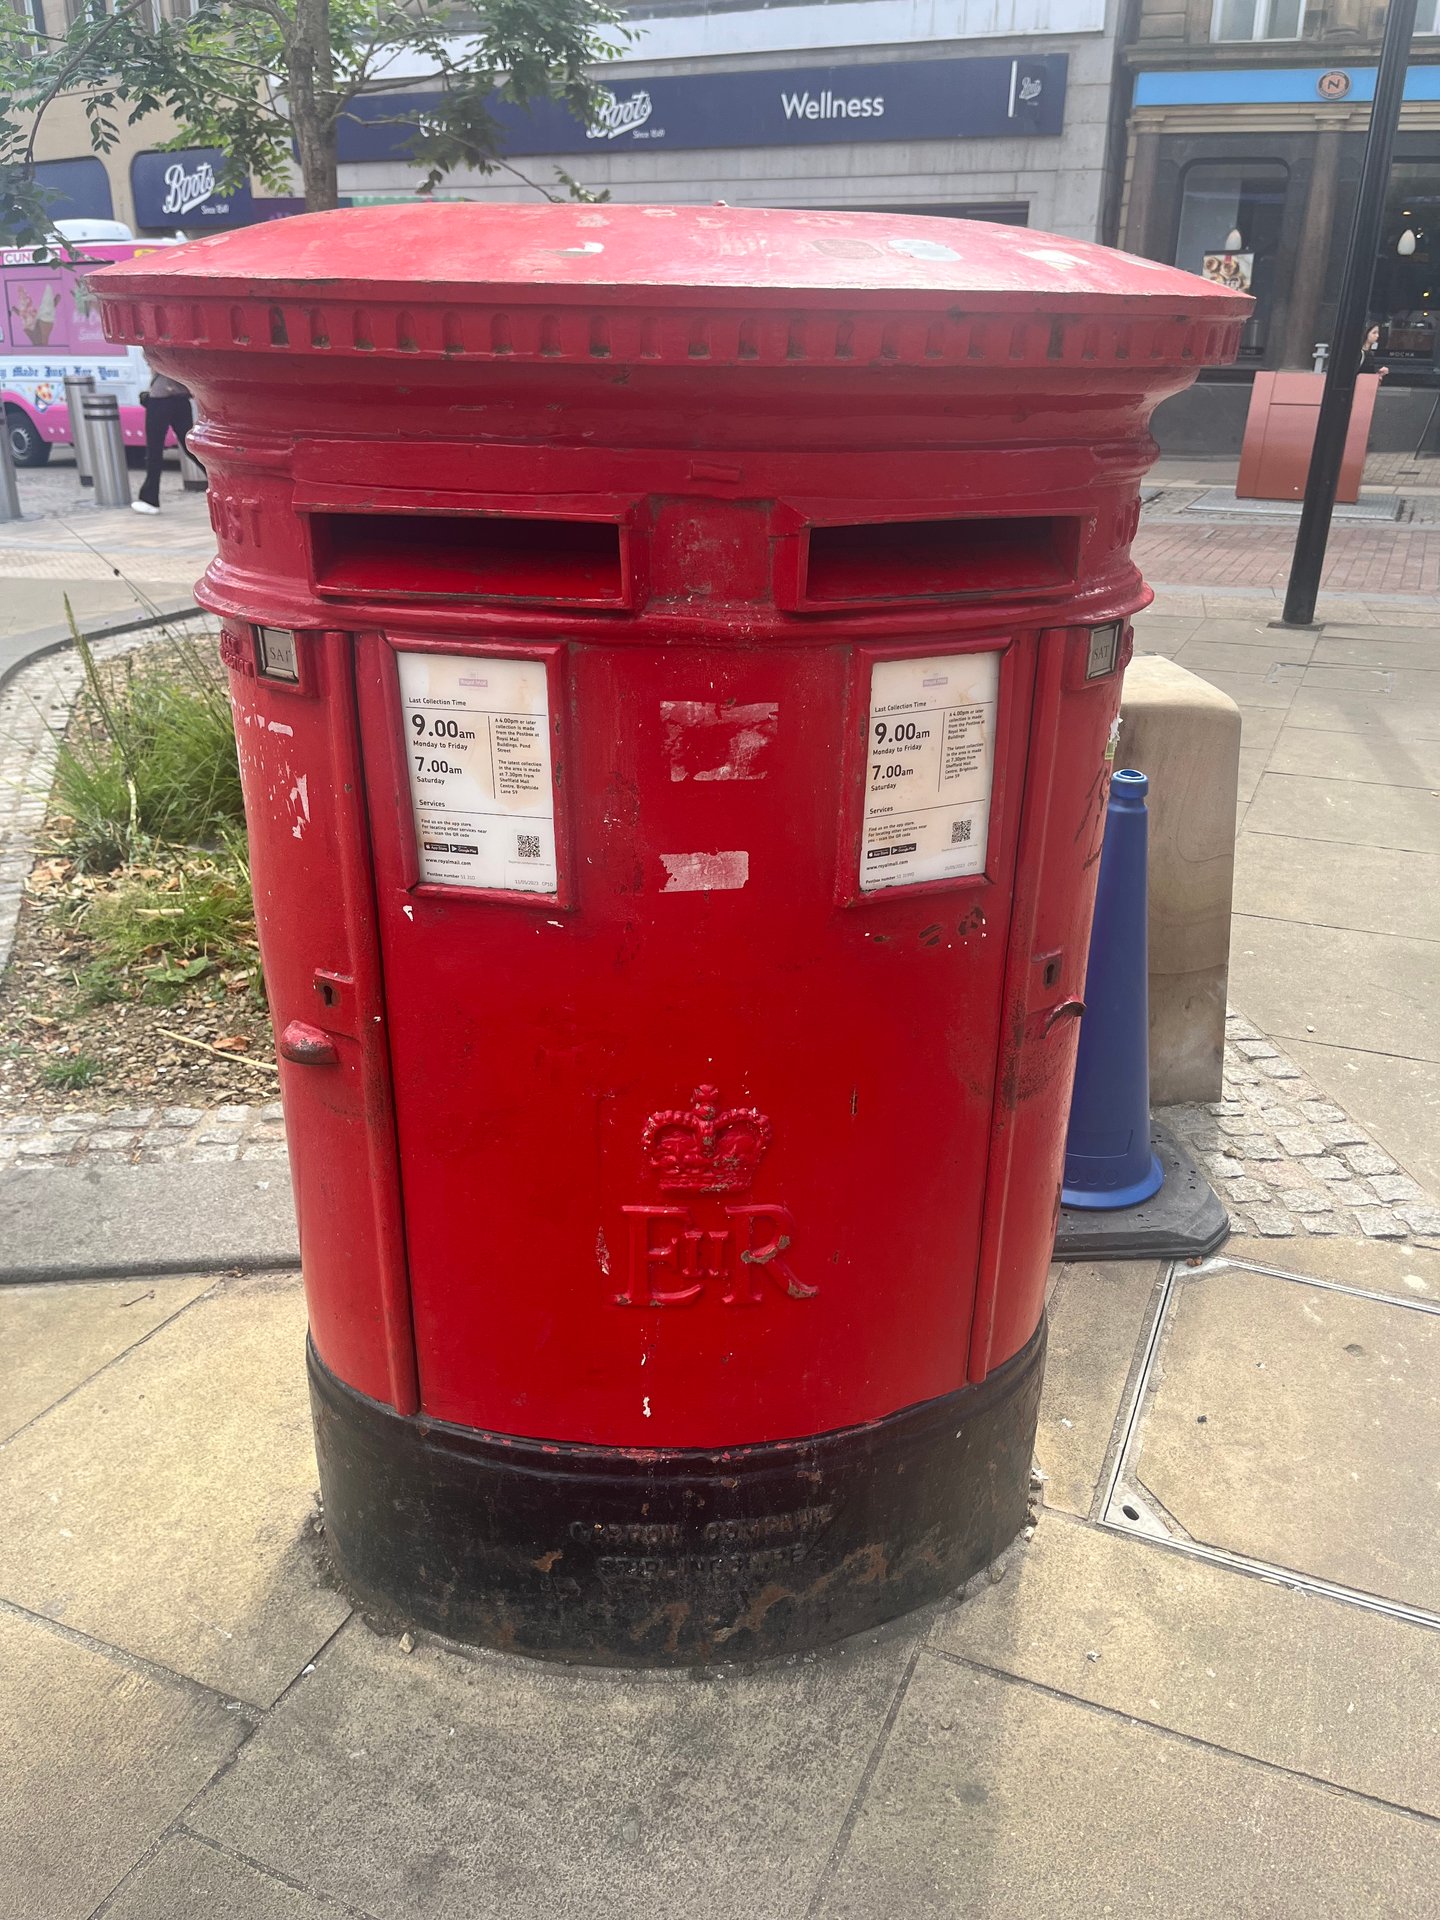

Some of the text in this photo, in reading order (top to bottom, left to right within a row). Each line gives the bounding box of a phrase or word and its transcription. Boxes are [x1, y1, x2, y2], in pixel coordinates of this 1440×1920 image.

[1328, 79, 1340, 90] N
[781, 90, 884, 120] Wellness
[586, 90, 652, 139] Boots
[162, 162, 215, 215] Boots
[13, 366, 38, 377] Made
[98, 366, 119, 380] You
[1094, 644, 1110, 660] SAT
[412, 714, 475, 739] 9.00am
[875, 722, 930, 744] 9.00am
[413, 741, 437, 749] Monday
[448, 742, 468, 750] Friday
[415, 756, 462, 774] 7.00am
[872, 764, 914, 780] 7.00am
[417, 776, 445, 785] Saturday
[871, 783, 896, 791] Saturday
[870, 806, 893, 814] Services
[866, 860, 908, 870] www.royalmail.com
